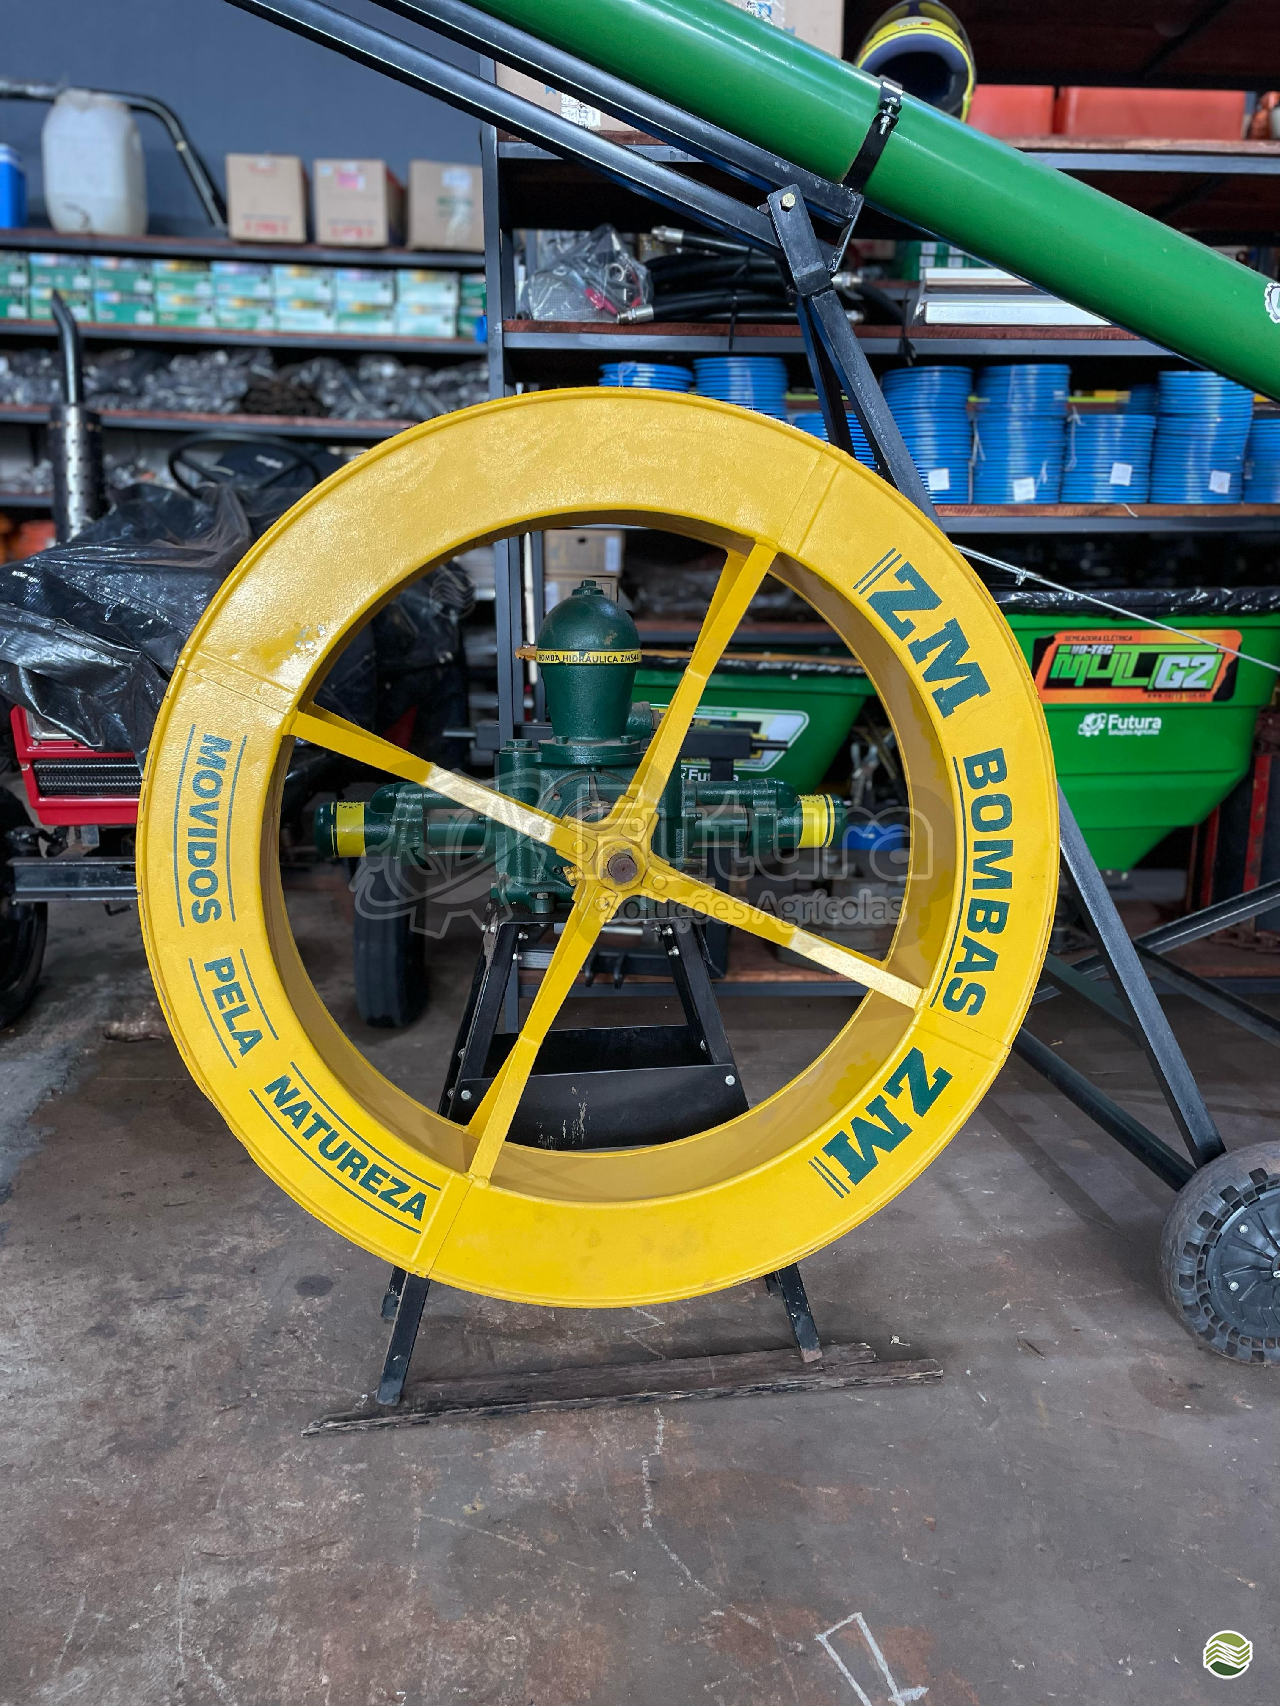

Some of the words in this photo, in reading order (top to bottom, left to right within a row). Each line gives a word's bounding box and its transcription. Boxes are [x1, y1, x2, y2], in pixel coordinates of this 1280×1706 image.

[538, 654, 560, 662] BOMBA
[562, 652, 618, 663] HIDRÁULICA
[867, 562, 990, 718] ZM
[1103, 634, 1133, 642] ELÉTRICA
[1153, 654, 1216, 690] G2
[1108, 713, 1162, 730] Futura
[187, 734, 233, 924] MOVIDOS
[943, 747, 1012, 1016] BOMBAS
[203, 956, 263, 1056] PELA
[264, 1074, 426, 1221] NATUREZA
[822, 1047, 952, 1184] ZM
